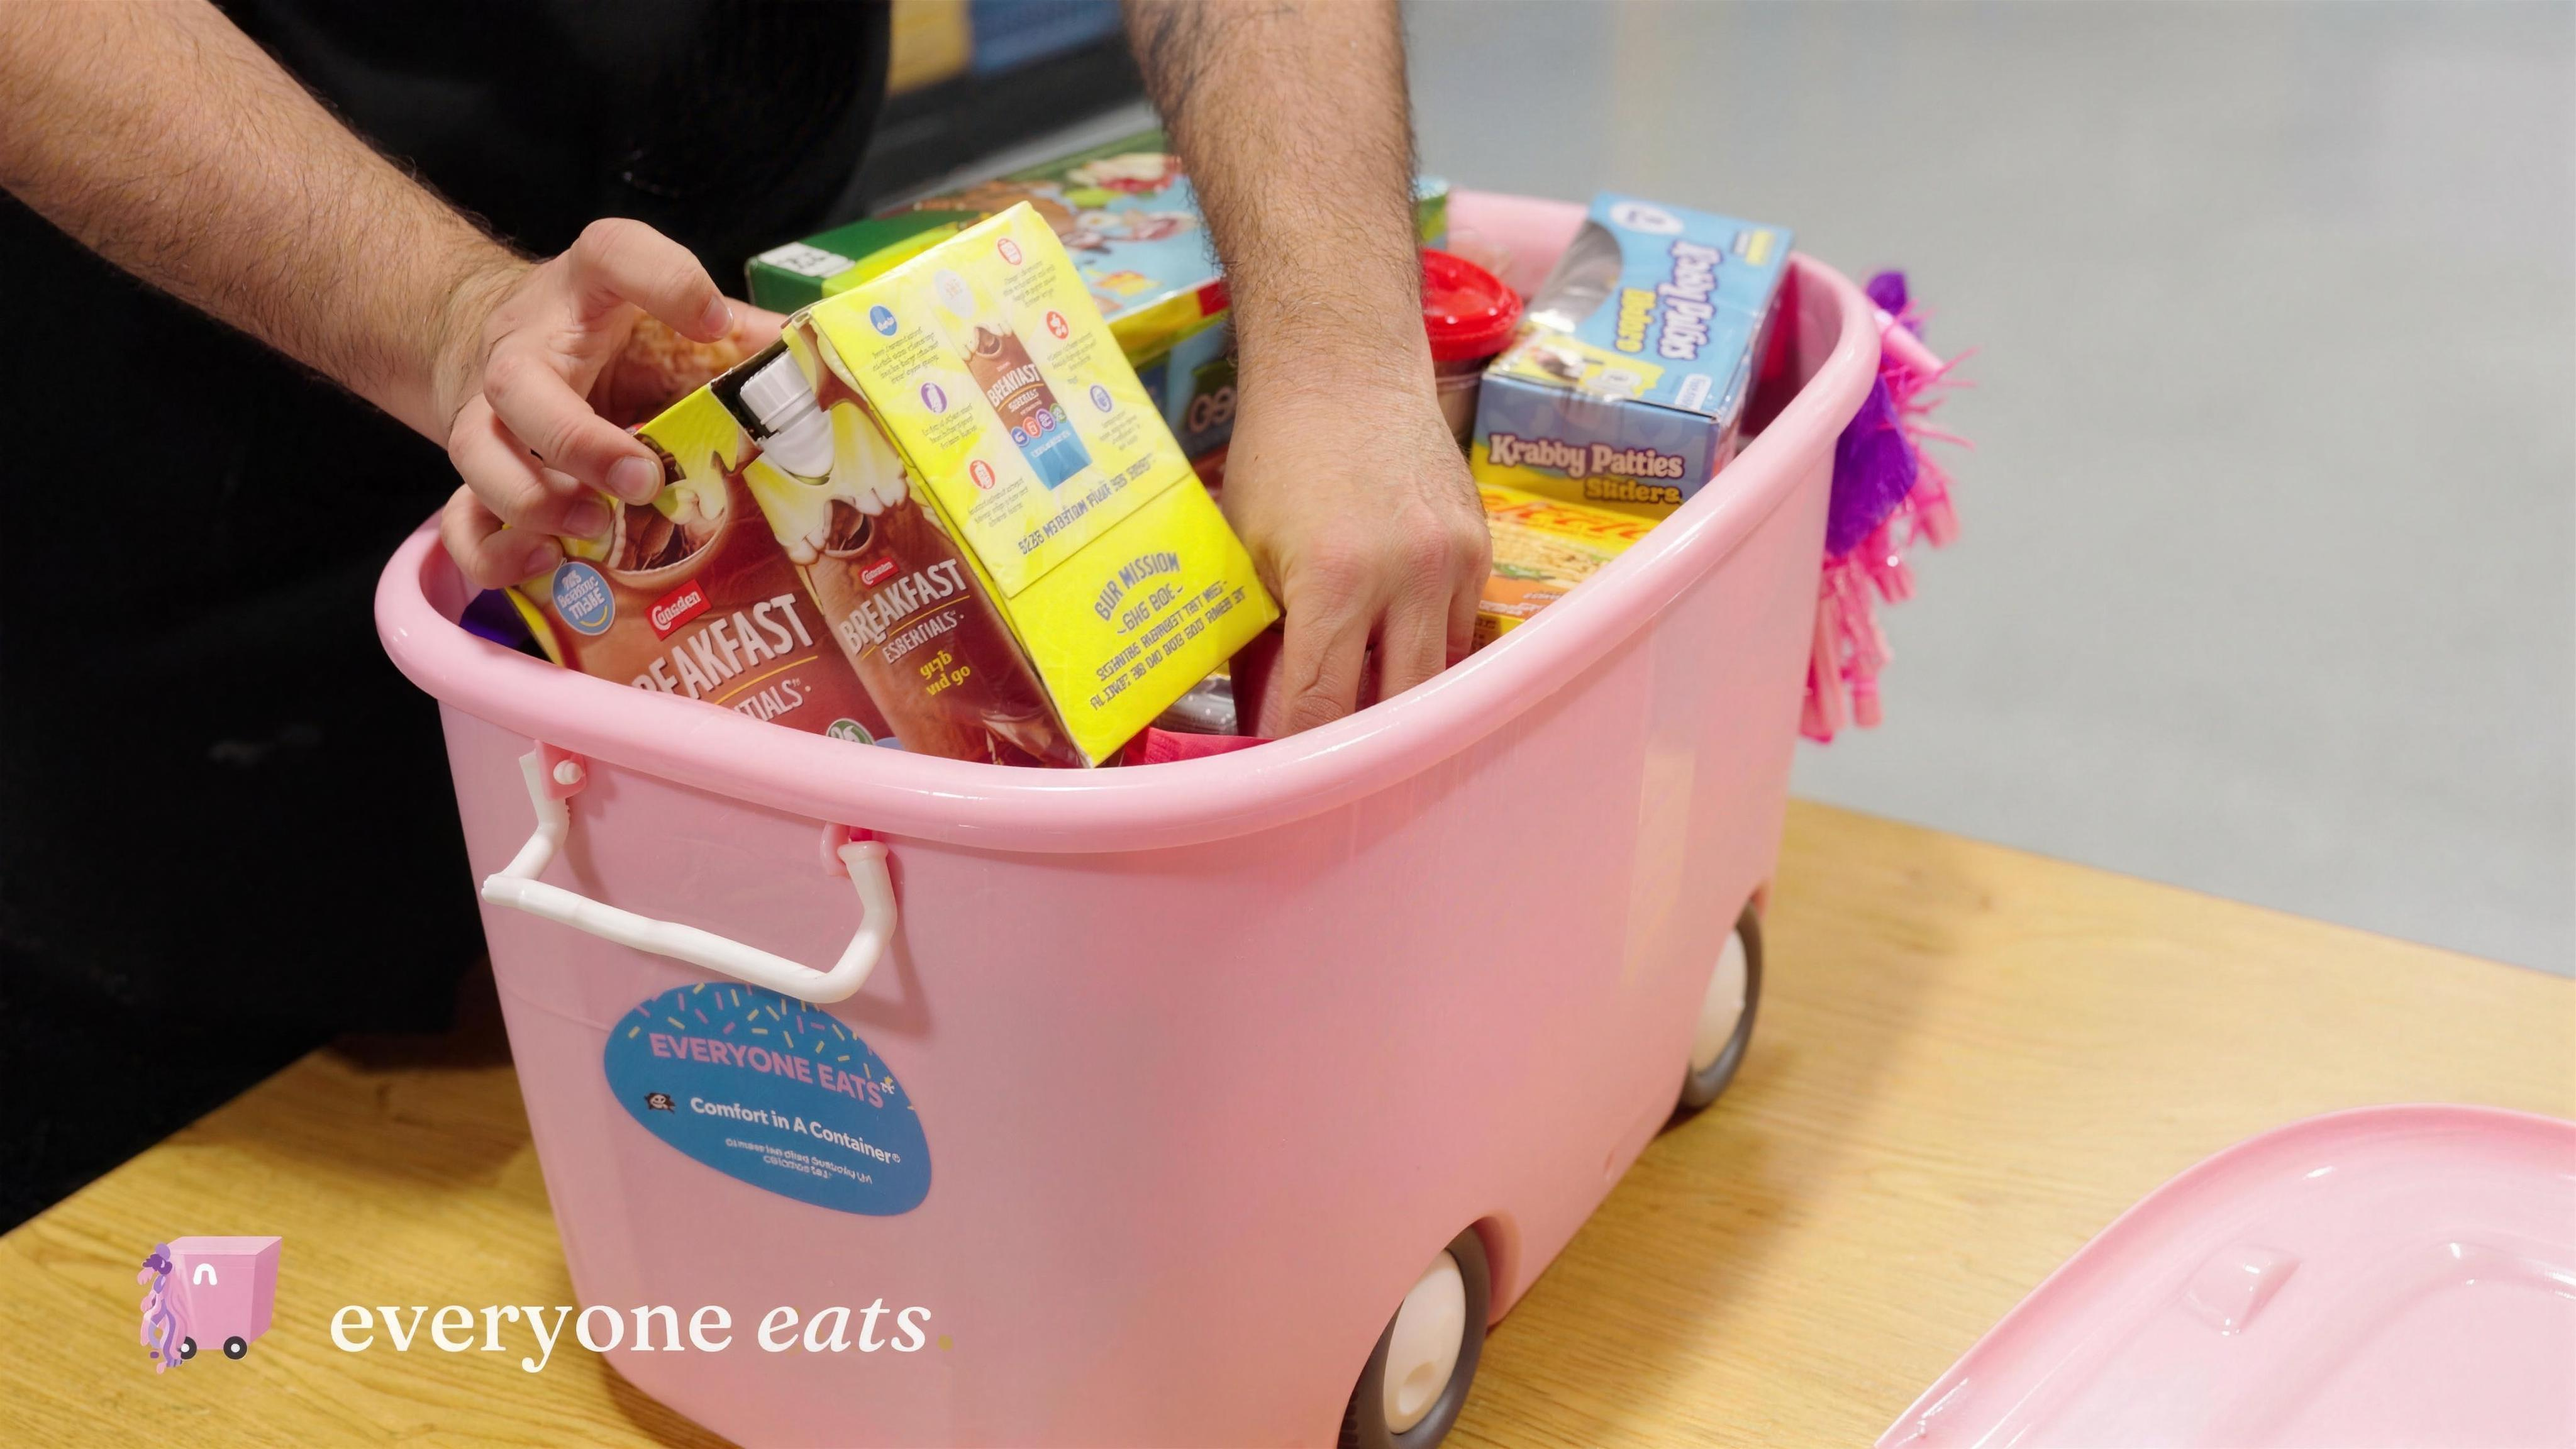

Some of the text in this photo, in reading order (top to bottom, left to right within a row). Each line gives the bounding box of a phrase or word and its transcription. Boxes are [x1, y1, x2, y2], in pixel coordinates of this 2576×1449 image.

[1489, 433, 1685, 478] Krabby Patties
[839, 558, 967, 655] BREAKFAST
[631, 594, 814, 699] EAKFAST
[951, 666, 970, 686] go
[649, 1033, 884, 1109] EVERYONE EATS
[691, 1097, 768, 1126] Comfort
[771, 1110, 790, 1131] in
[793, 1117, 808, 1135] A
